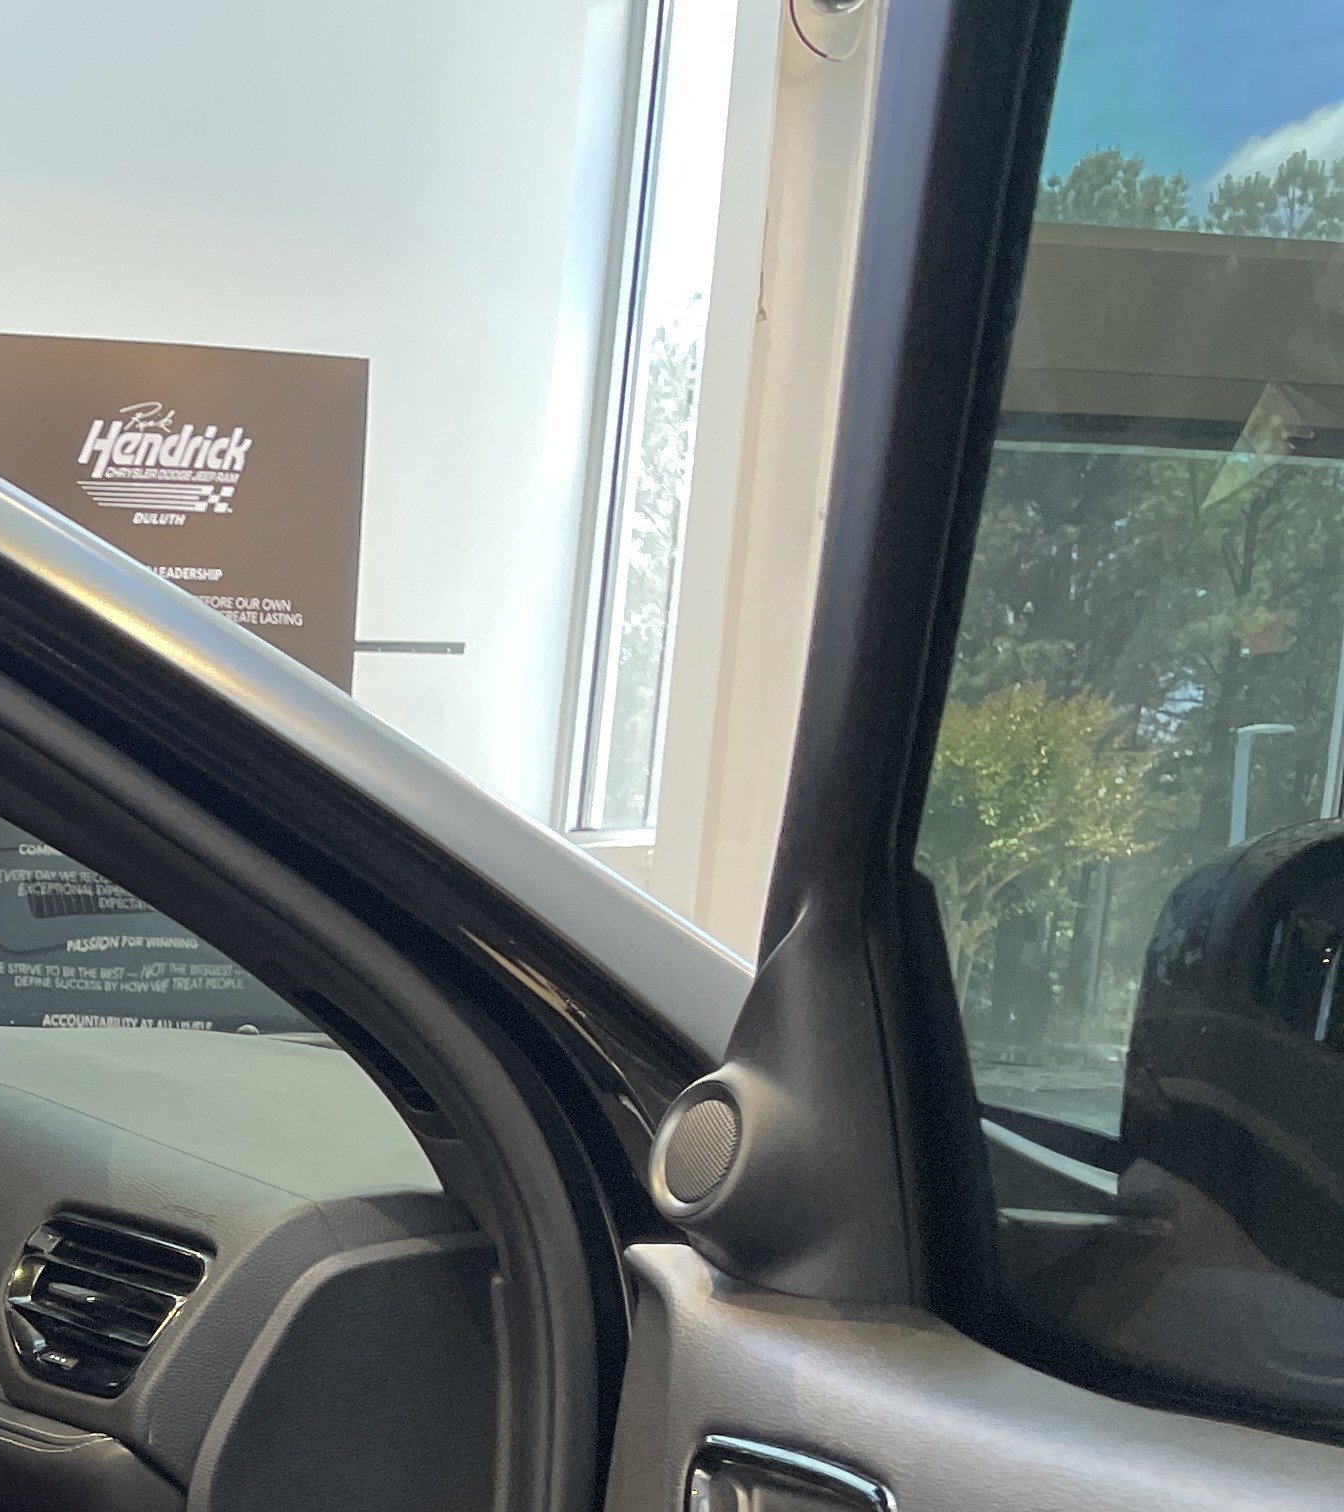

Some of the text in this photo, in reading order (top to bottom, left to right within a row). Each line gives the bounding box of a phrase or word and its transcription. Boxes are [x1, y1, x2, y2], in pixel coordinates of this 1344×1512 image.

[77, 420, 252, 479] Hendrick
[132, 512, 187, 525] DULUTH
[235, 597, 260, 610] OUR
[261, 598, 292, 611] OWN
[259, 611, 303, 626] LASTING
[34, 869, 58, 881] DAY
[66, 935, 199, 953] PASSION FOR WINNING
[7, 963, 42, 975] STRIVE
[45, 965, 61, 976] TO
[77, 966, 98, 978] THE
[140, 962, 166, 979] NOT
[54, 977, 102, 990] SUCCESS
[104, 980, 119, 992] BY
[172, 977, 204, 990] TREAT
[42, 1013, 138, 1028] ACCOUNTABILITY
